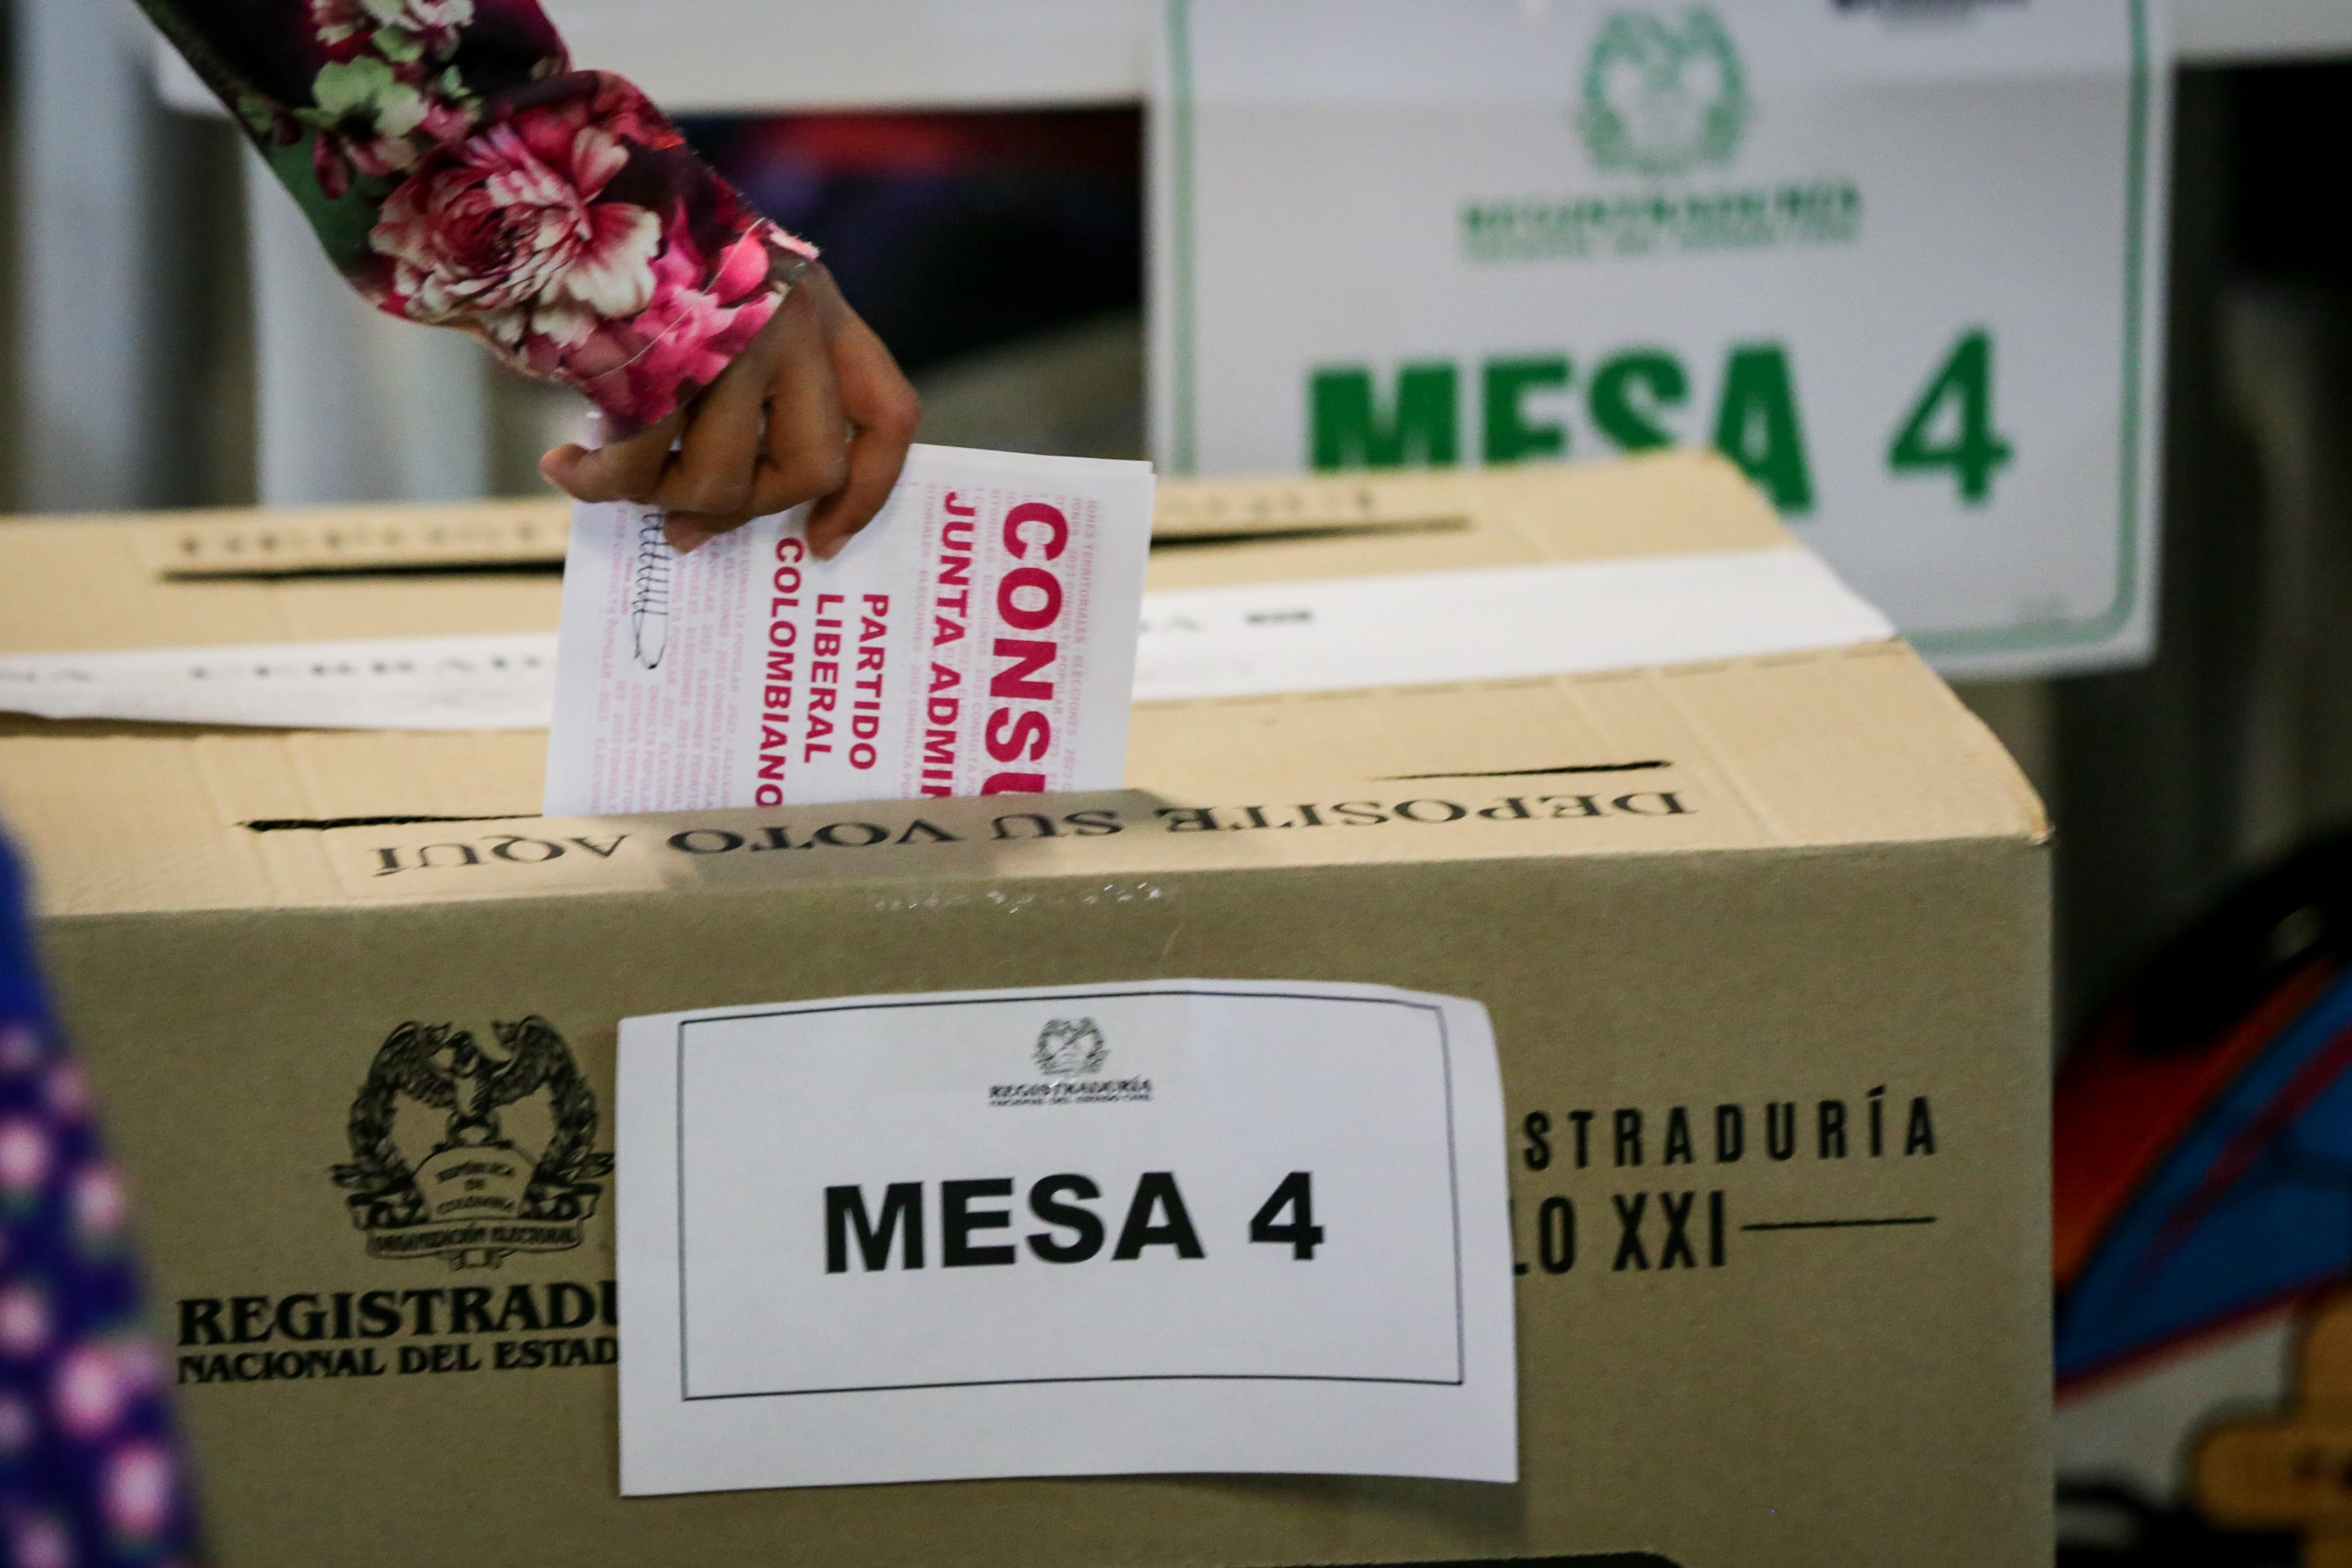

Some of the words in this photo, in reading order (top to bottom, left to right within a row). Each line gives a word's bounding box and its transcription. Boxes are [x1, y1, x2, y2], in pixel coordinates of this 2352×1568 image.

[1306, 339, 1816, 514] MESA
[1885, 326, 2013, 505] 4
[933, 492, 975, 646] JUNTA
[1074, 544, 1094, 645] TERRITORIALES
[756, 538, 804, 806] COLOMBIANO
[805, 594, 844, 763] LIBERAL
[849, 594, 889, 769] PARTIDO
[1066, 654, 1084, 737] ELECCIONES
[967, 702, 982, 773] CONSULTA
[1062, 747, 1076, 778] 2023
[667, 819, 963, 854] VOTO
[991, 808, 1124, 840] SU
[1157, 791, 1698, 832] DEPOSITE
[373, 832, 630, 878] AQUÍ
[1523, 1084, 1937, 1172] STRADURÍA
[823, 1170, 1207, 1275] MESA
[1248, 1171, 1325, 1262] 4
[1611, 1189, 1726, 1272] XXI
[177, 1346, 384, 1384] NACIONAL
[396, 1343, 481, 1375] DEL
